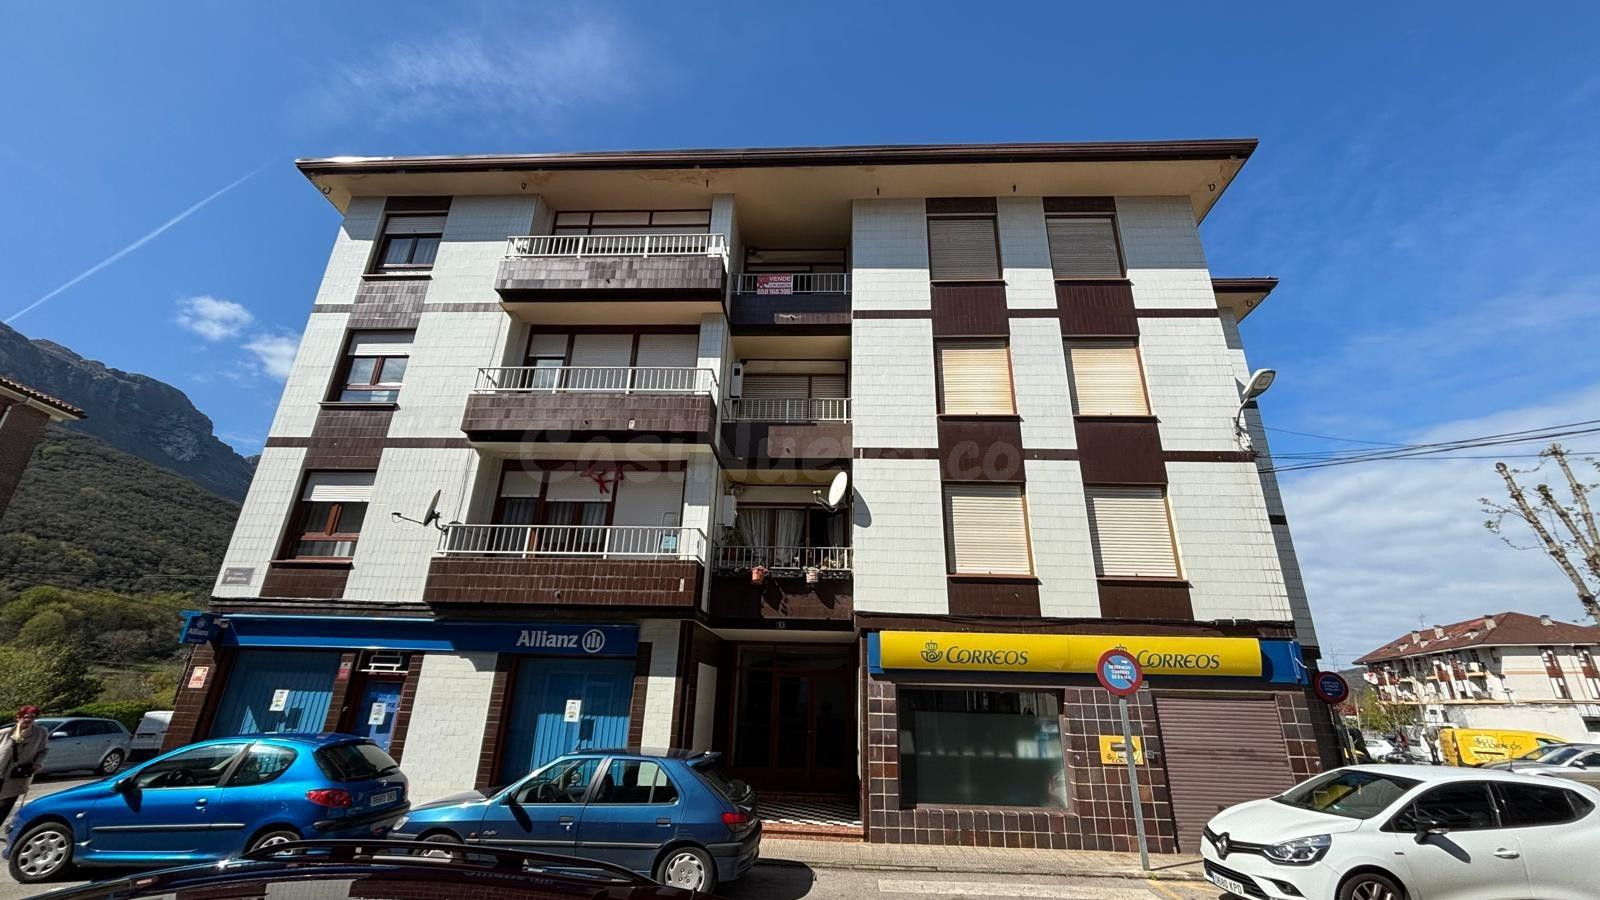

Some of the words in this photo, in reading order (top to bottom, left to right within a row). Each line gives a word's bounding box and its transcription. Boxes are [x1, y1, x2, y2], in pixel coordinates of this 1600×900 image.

[188, 627, 209, 636] Allianz
[516, 630, 578, 648] Allianz
[946, 646, 1028, 665] CORREOS
[1137, 650, 1220, 669] CORREOS
